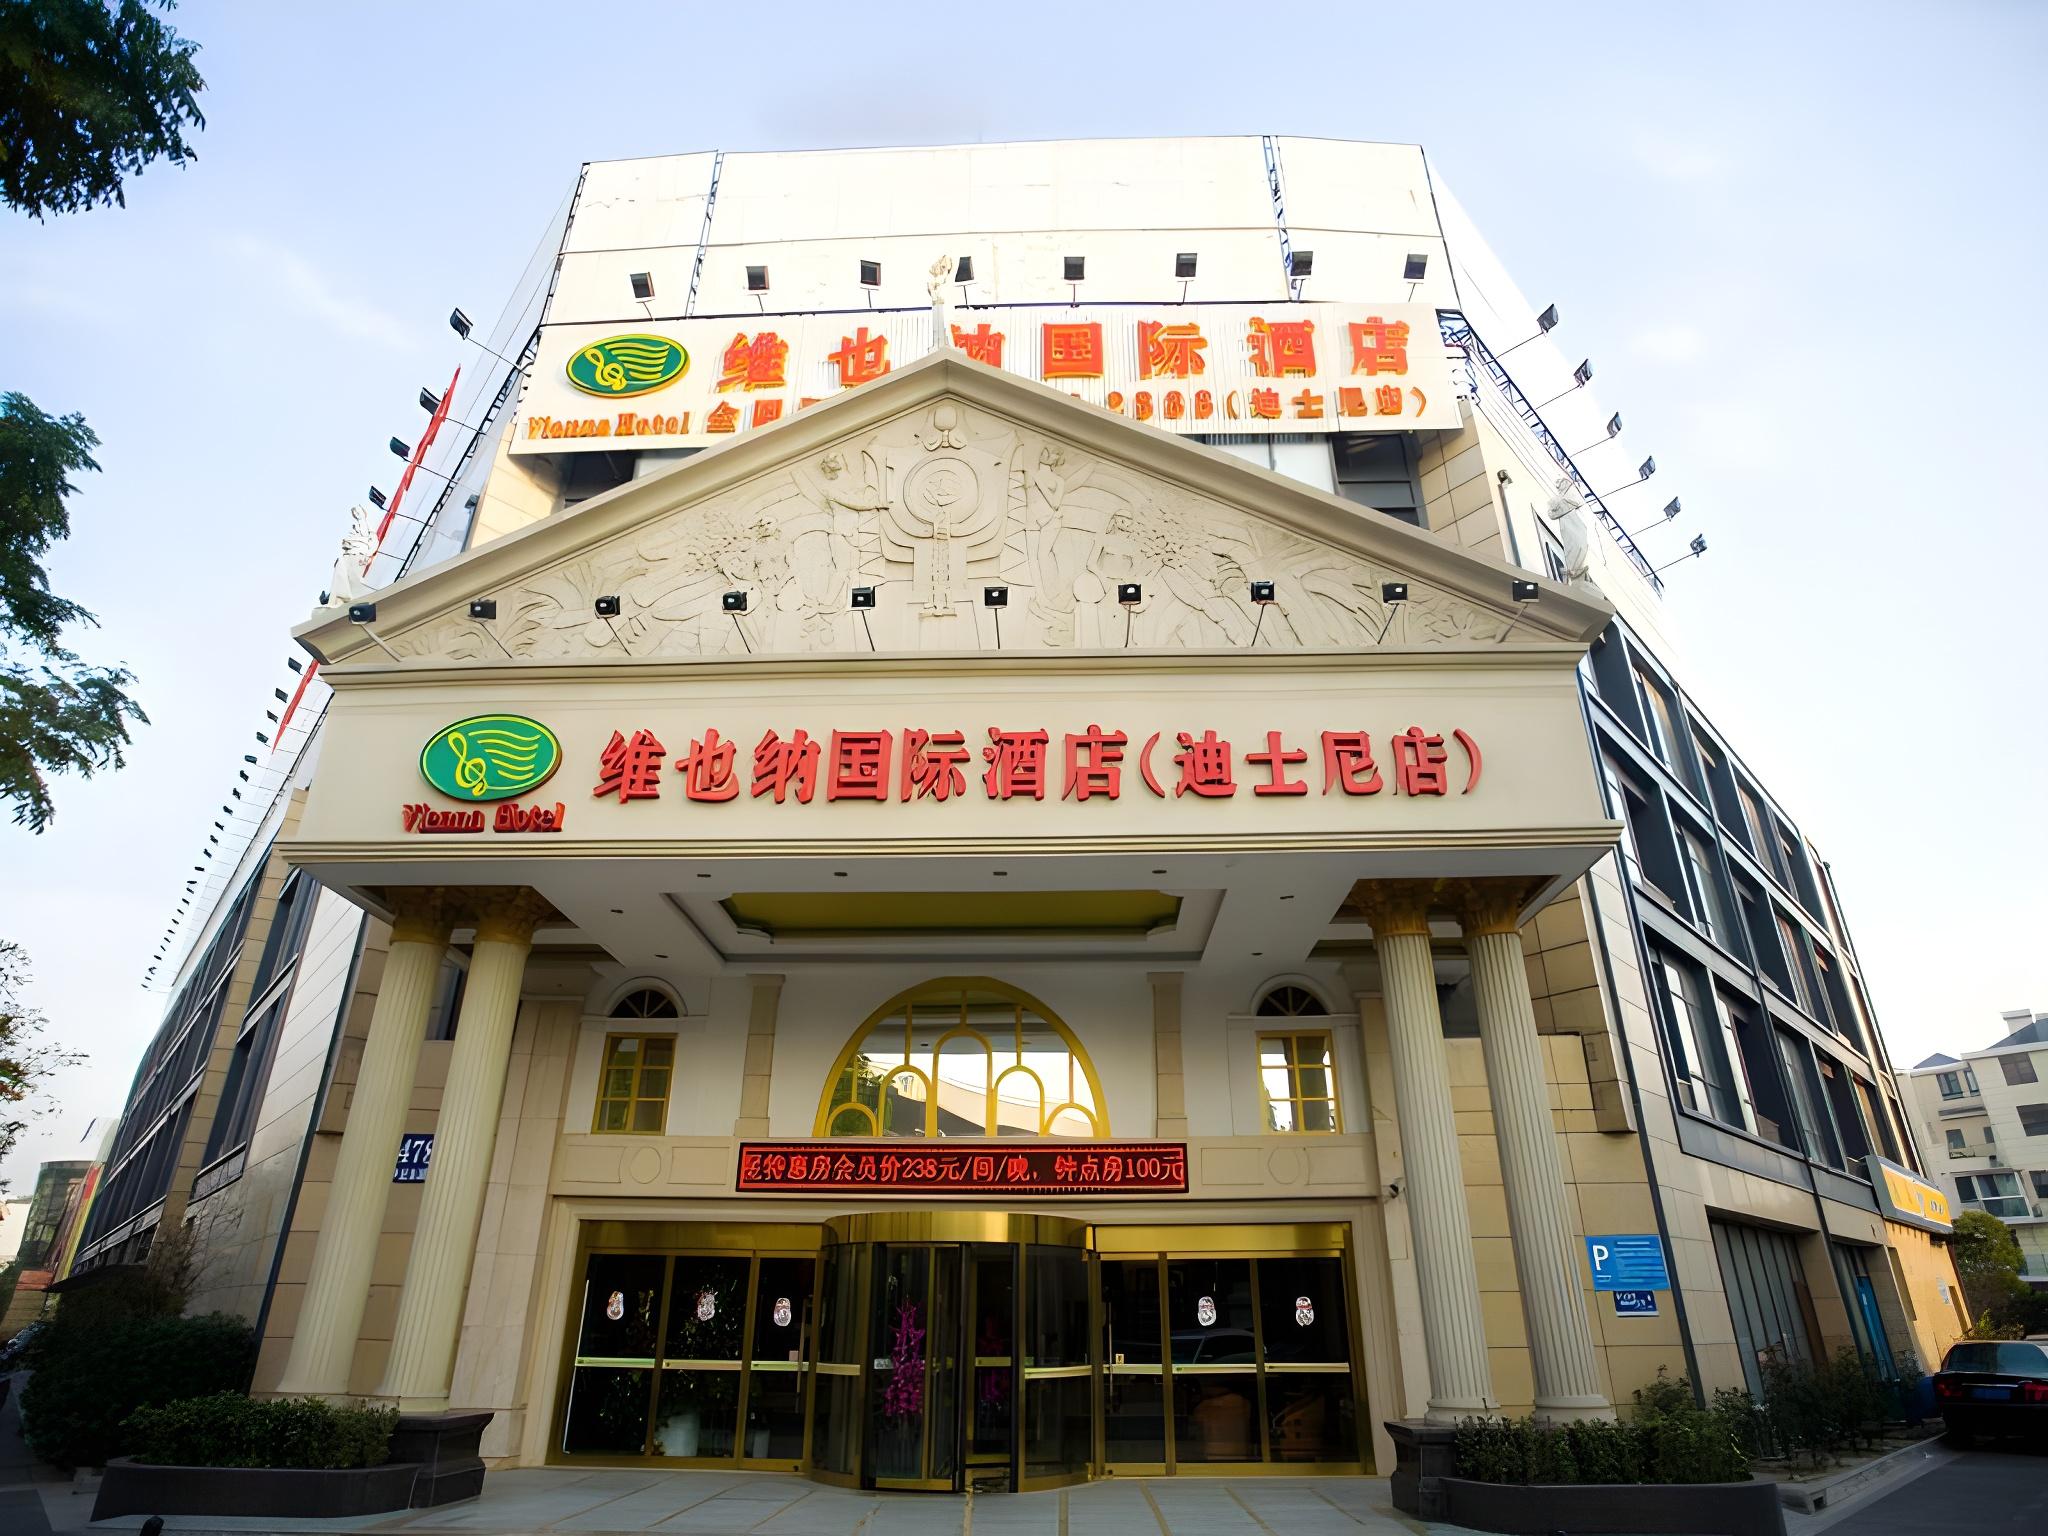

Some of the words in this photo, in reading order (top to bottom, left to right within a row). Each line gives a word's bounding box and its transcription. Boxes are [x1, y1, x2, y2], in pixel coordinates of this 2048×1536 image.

[716, 316, 1410, 392] 维也纳国际酒店
[593, 723, 1483, 805] 维也纳国际酒店(迪士尼店)
